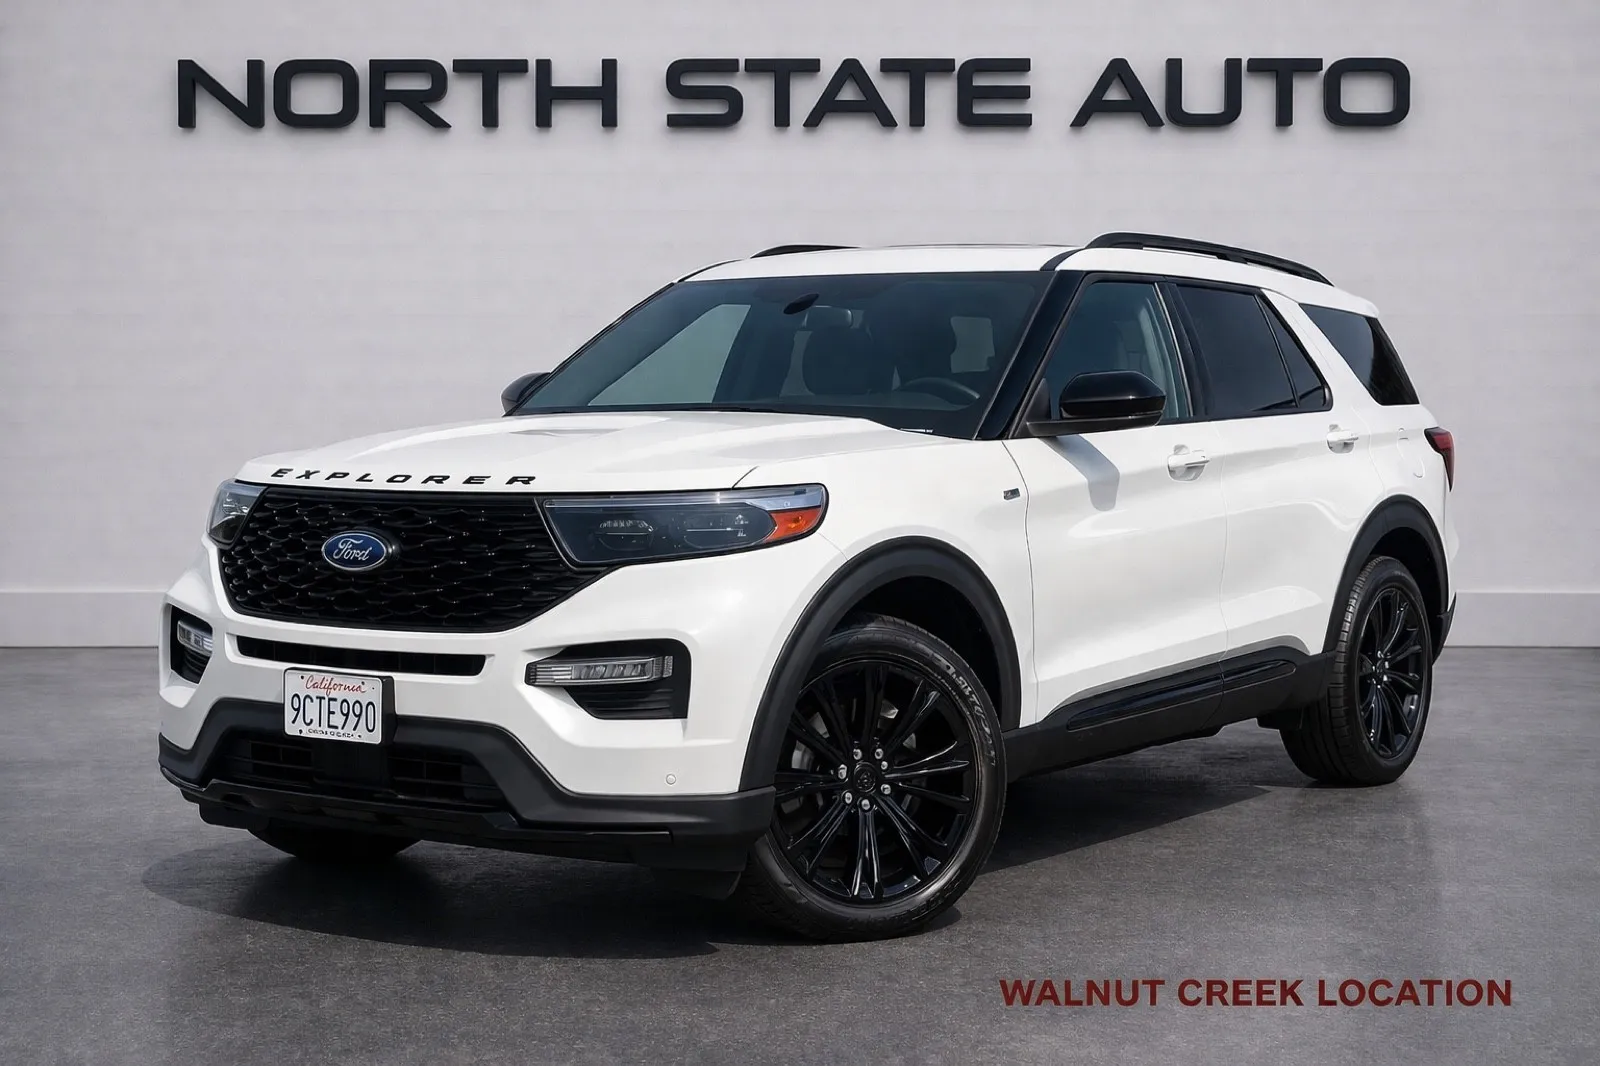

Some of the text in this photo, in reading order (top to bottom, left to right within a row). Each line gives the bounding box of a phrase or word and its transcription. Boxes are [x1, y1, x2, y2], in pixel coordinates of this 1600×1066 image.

[177, 57, 1411, 132] NORTH STATE AUTO
[270, 467, 537, 486] EXPLORER
[332, 537, 372, 562] Ford
[305, 674, 367, 697] California
[290, 692, 376, 734] 9CTE990
